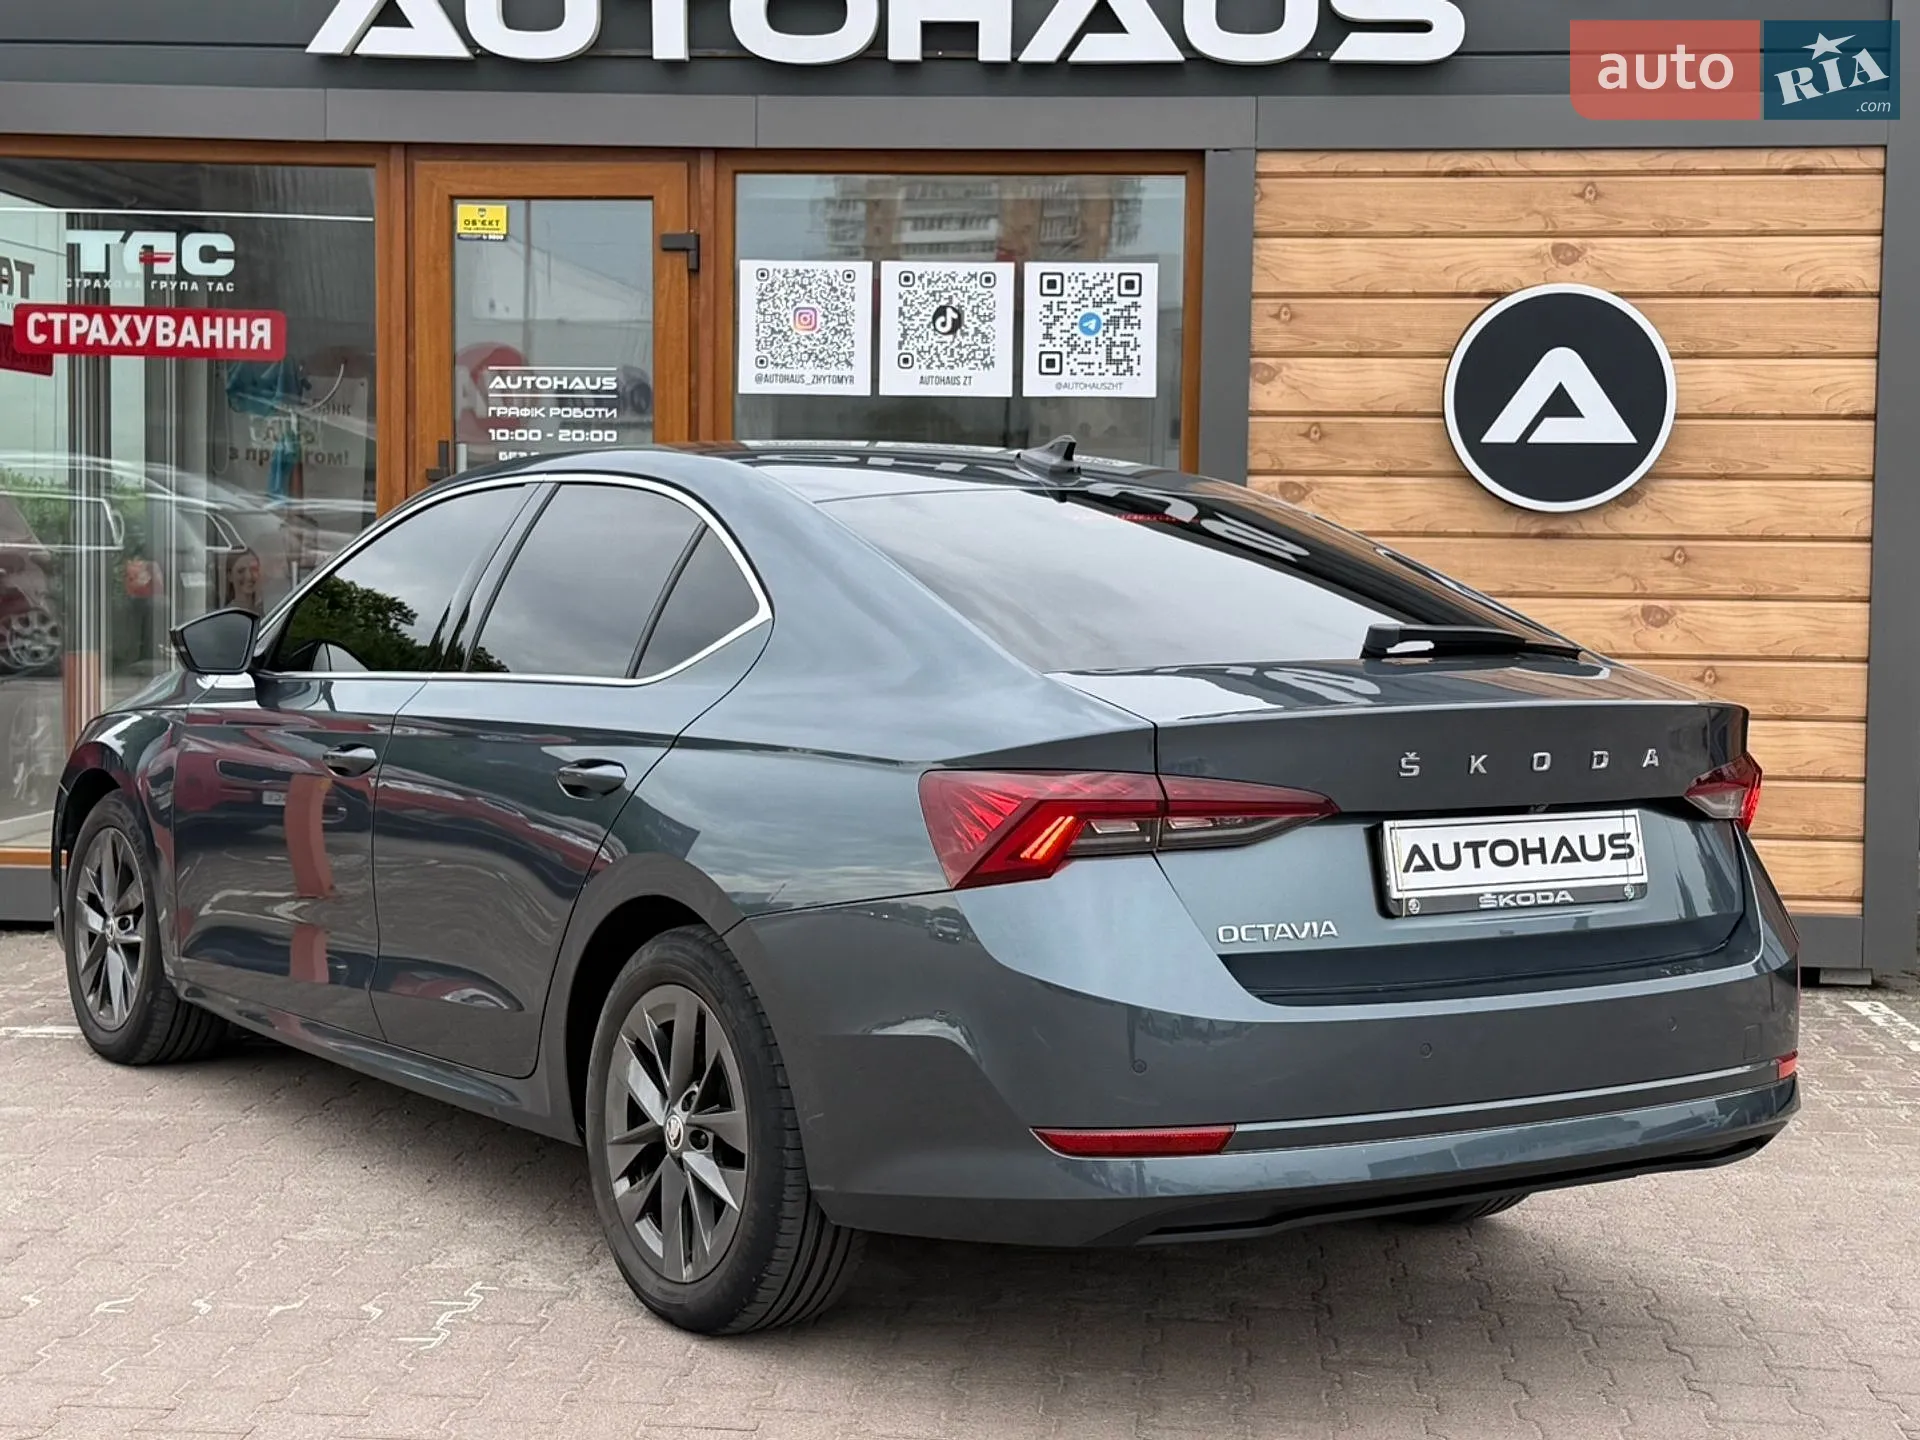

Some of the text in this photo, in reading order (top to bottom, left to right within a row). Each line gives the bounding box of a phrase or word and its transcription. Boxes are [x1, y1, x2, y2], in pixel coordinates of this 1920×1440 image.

[150, 280, 200, 292] ГРУПА
[206, 281, 235, 293] ТАС
[26, 312, 272, 351] СТРАХУВАННЯ
[488, 376, 618, 391] AUTOHAUS
[919, 375, 973, 386] AUTOHAUS ZT
[488, 406, 618, 419] ГРАФІК РОБОТИ
[488, 428, 542, 442] 10:00
[557, 429, 618, 443] 20:00
[1399, 747, 1660, 778] ŠKODA
[1402, 832, 1636, 874] AUTOHAUS
[1478, 890, 1575, 909] ŠKODA
[1217, 919, 1340, 944] OCTAVIA
